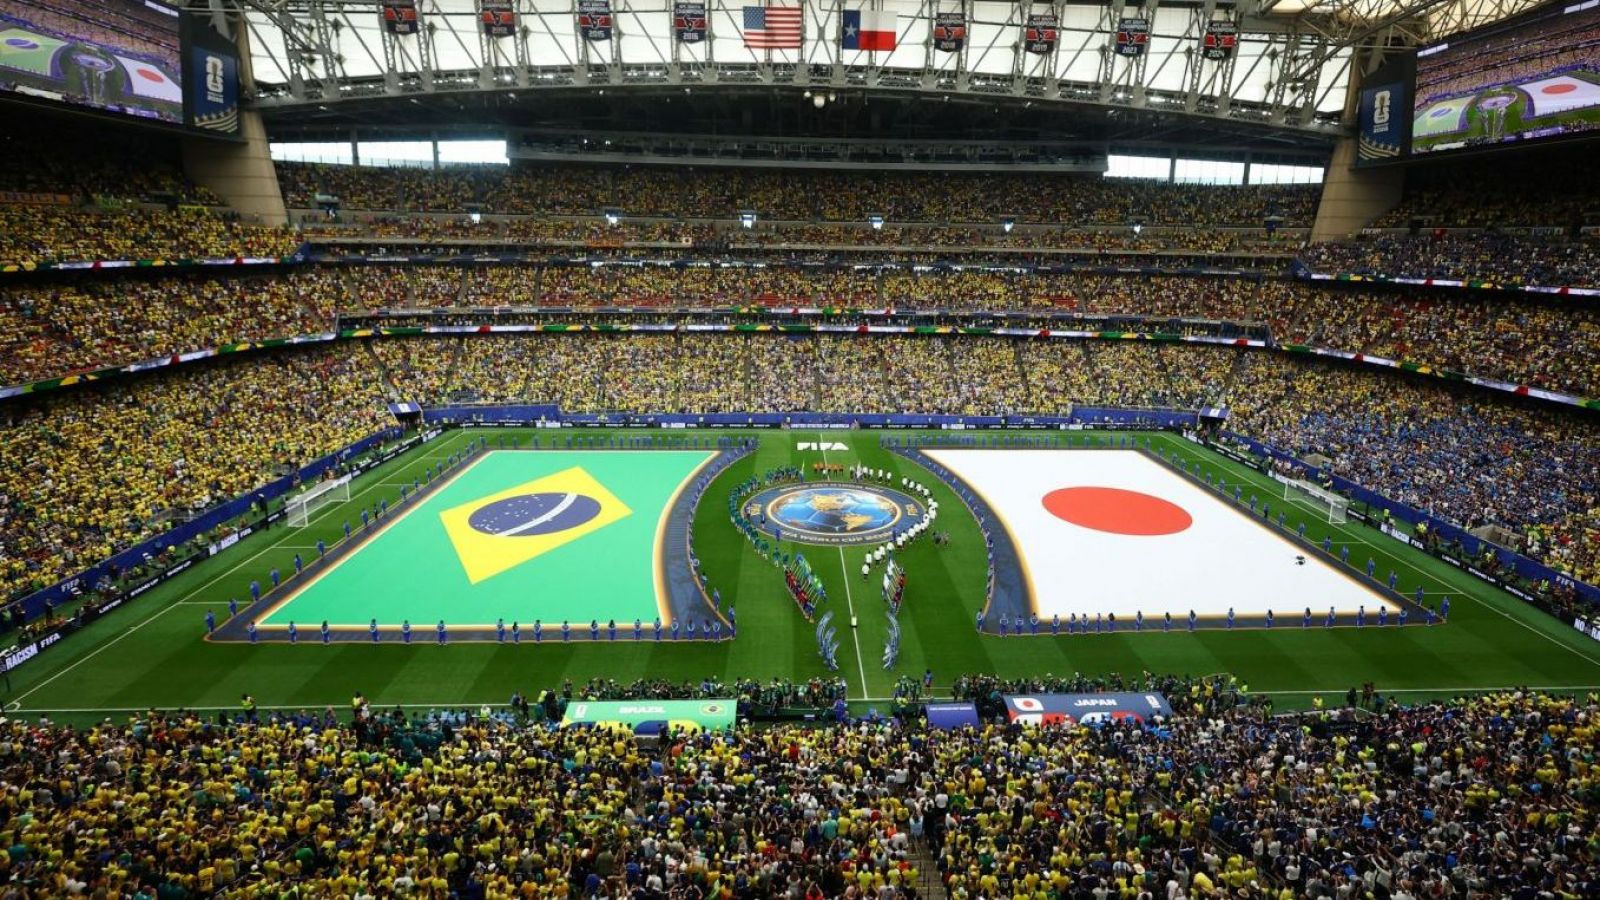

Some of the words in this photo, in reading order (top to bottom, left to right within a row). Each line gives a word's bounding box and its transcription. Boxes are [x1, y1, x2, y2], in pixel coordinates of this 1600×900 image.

[797, 442, 850, 450] FIFA
[1410, 540, 1424, 550] FIFA
[1574, 618, 1586, 632] NO
[6, 642, 38, 670] RACISM
[40, 632, 60, 648] FIFA
[619, 706, 666, 714] BRAZIL
